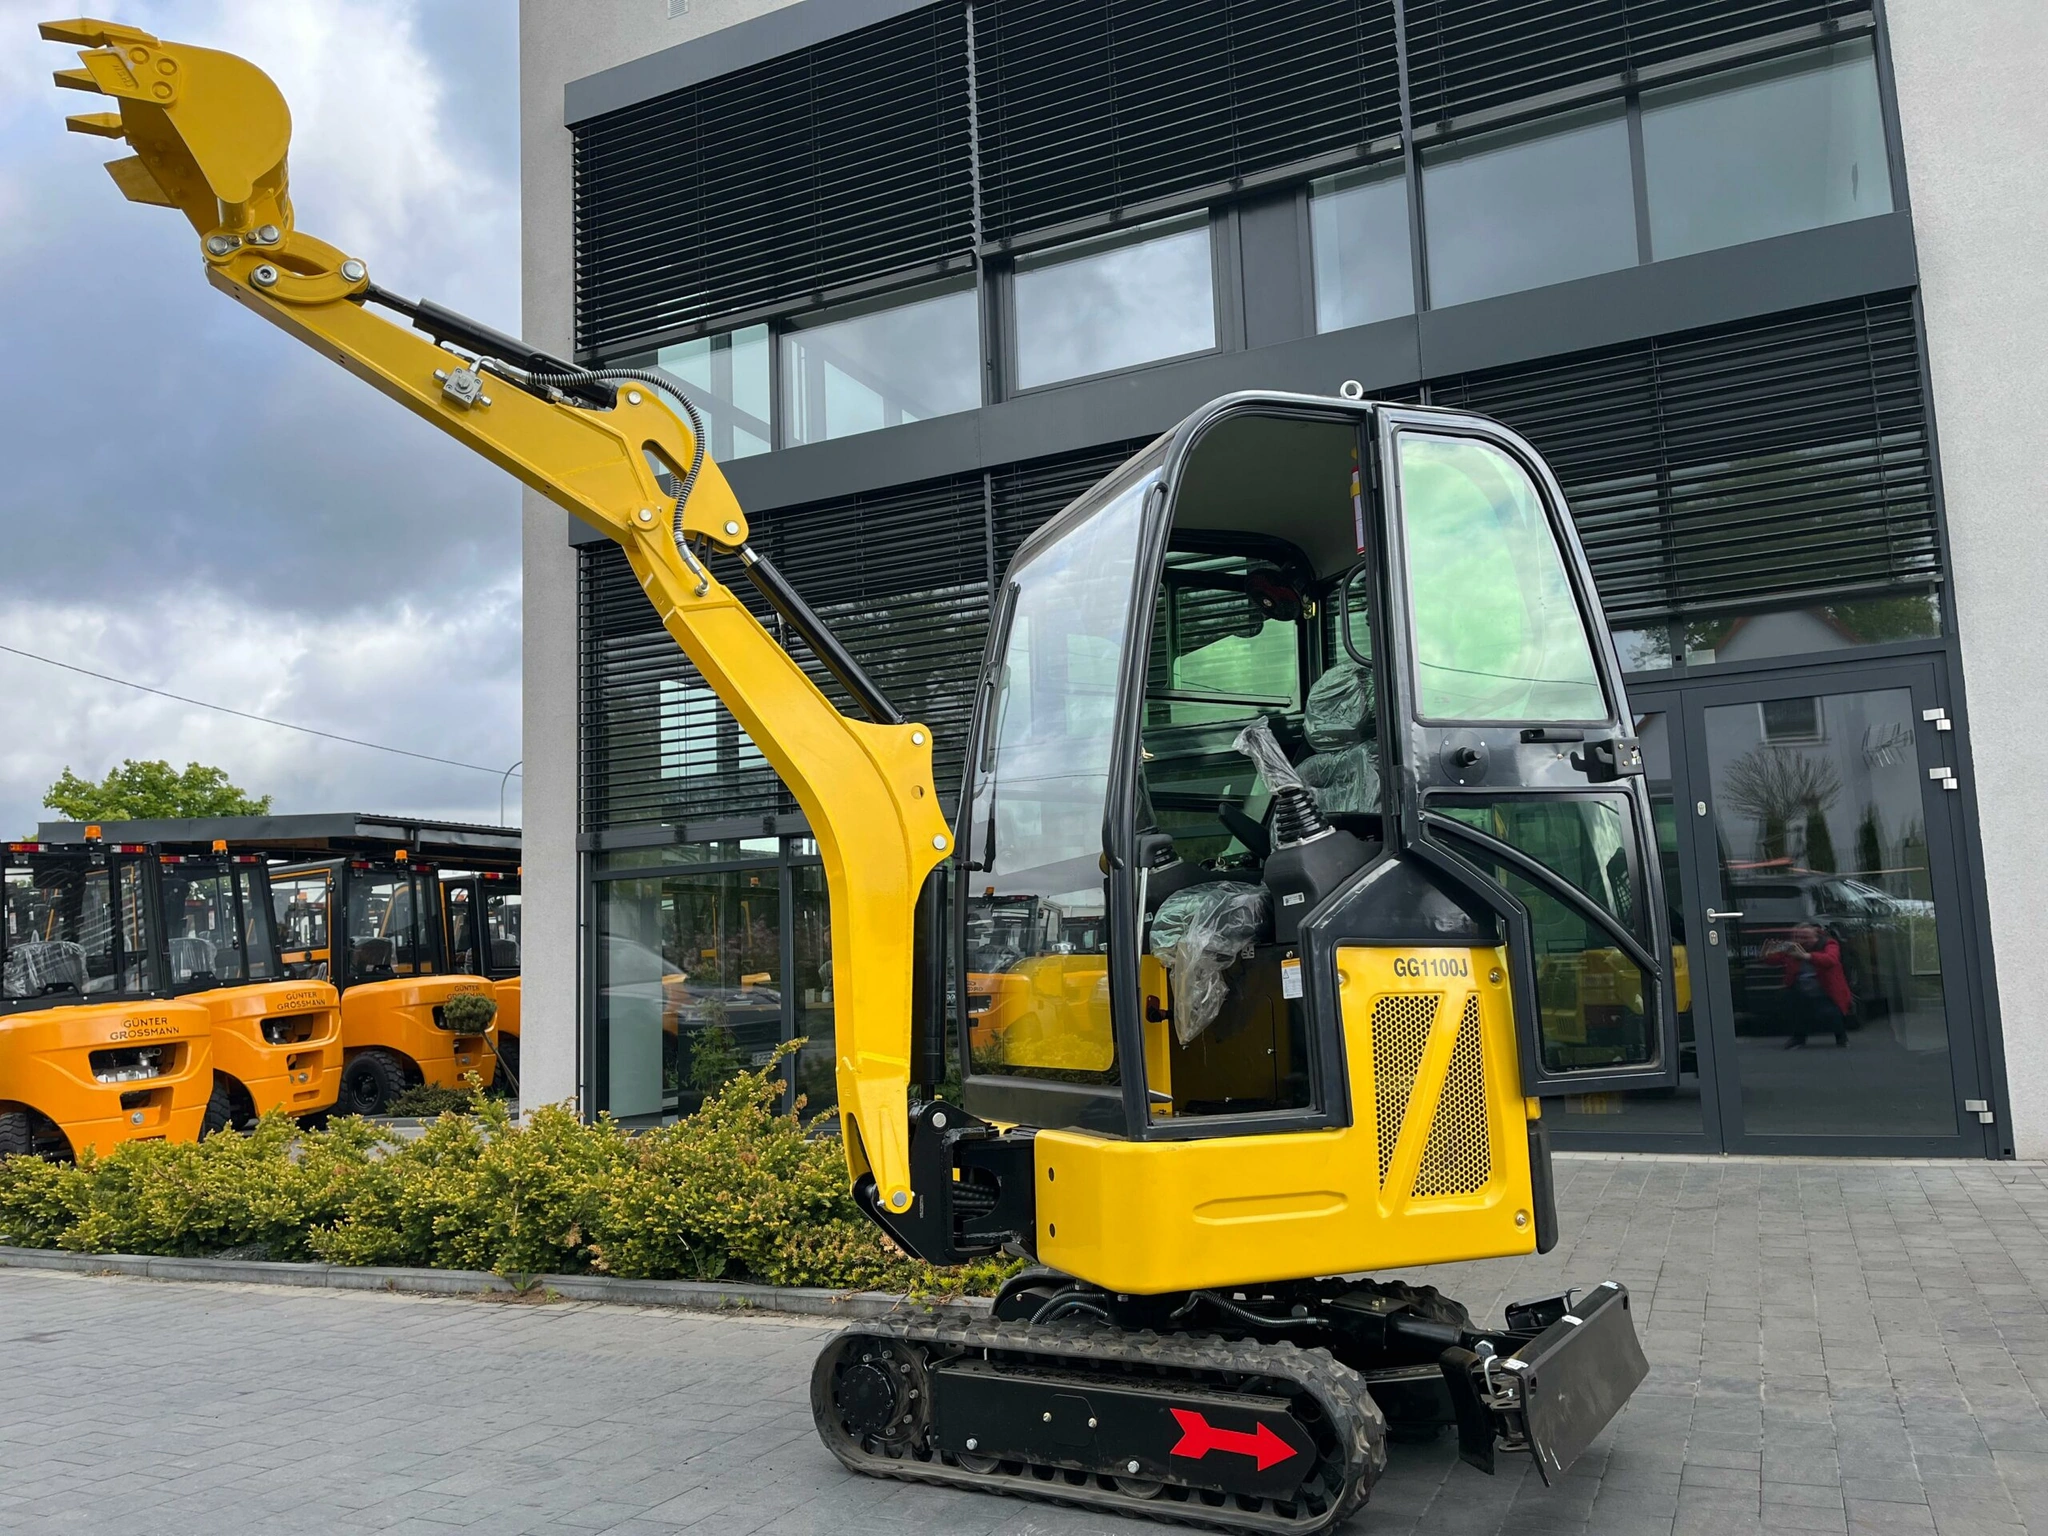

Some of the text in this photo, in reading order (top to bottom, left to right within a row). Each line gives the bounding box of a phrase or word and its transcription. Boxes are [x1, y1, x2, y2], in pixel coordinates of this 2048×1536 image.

[1393, 958, 1468, 977] GG1100J
[286, 991, 318, 1001] GÜNTER
[277, 998, 326, 1011] GROSSMANN
[123, 1017, 168, 1029] GÜNTER
[109, 1027, 180, 1041] GROSSMANN
